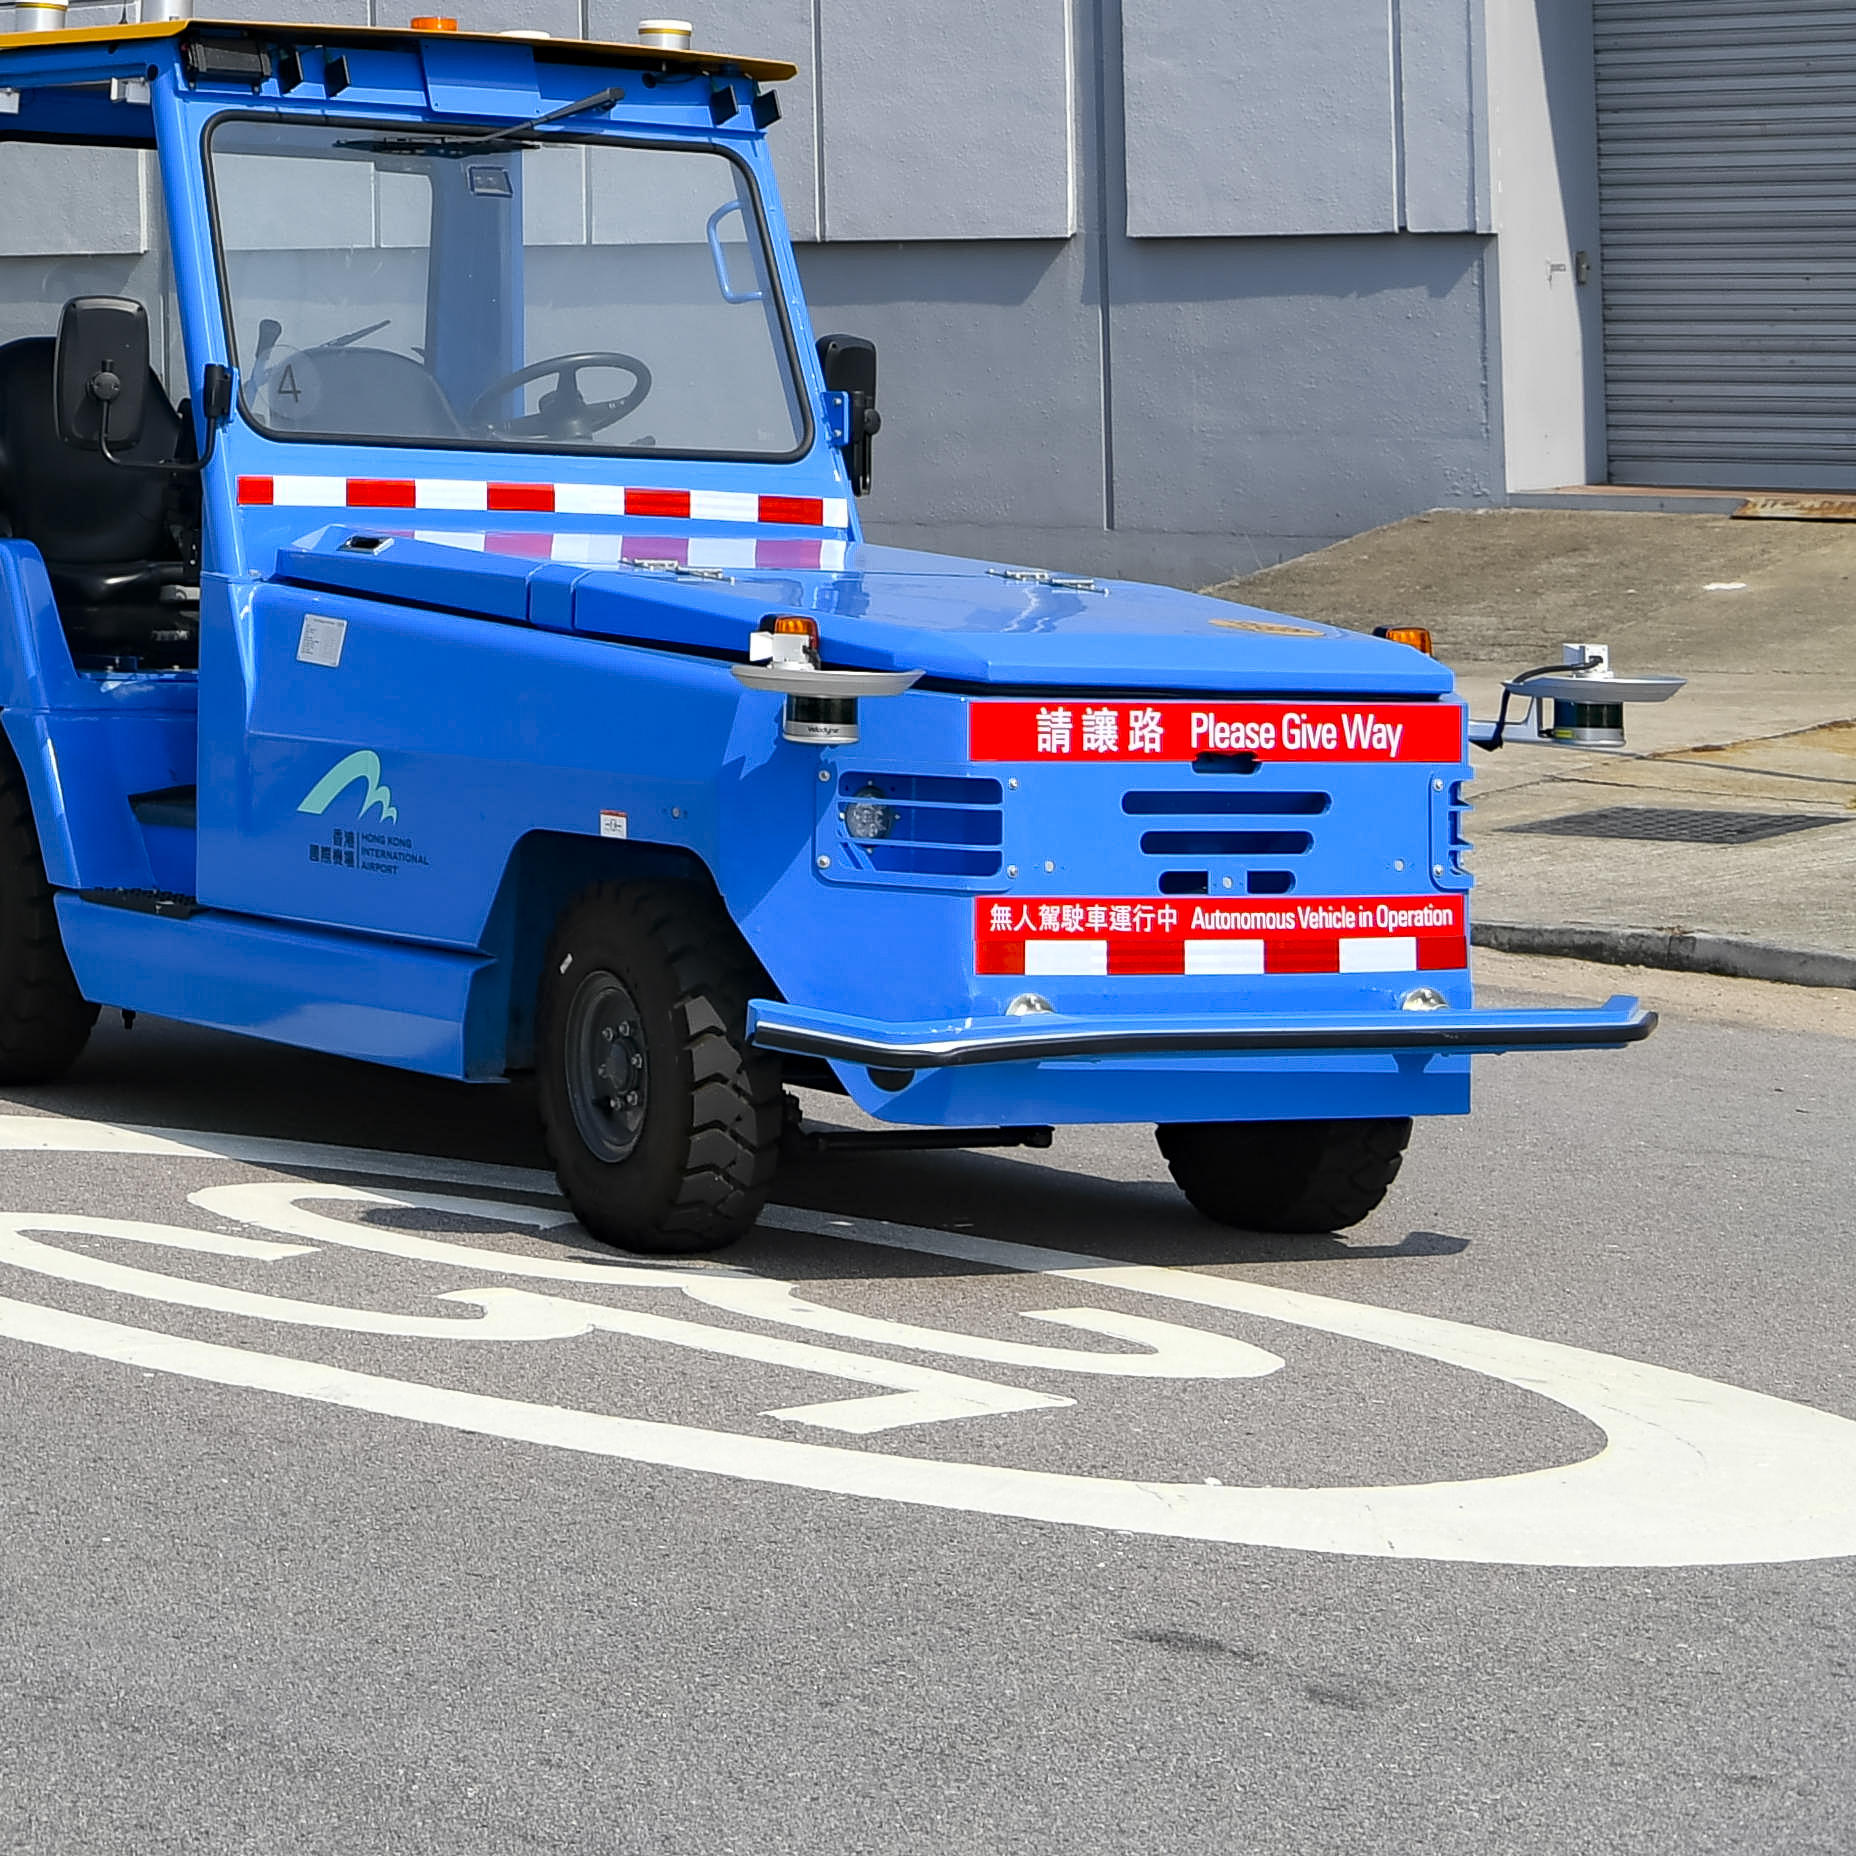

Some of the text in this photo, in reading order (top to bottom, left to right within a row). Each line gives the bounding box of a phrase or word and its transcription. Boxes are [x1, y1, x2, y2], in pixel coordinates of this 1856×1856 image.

[278, 364, 302, 403] 4
[1035, 707, 1163, 754] 請讓路
[1191, 712, 1402, 758] Please Give Way
[361, 833, 412, 848] HONG KONG
[361, 847, 429, 865] INTERNATIONAL
[361, 861, 398, 875] AIRPORT
[989, 903, 1178, 933] 無人駕駛車運行中
[1191, 903, 1454, 930] Autonomous Vehicle in Operation
